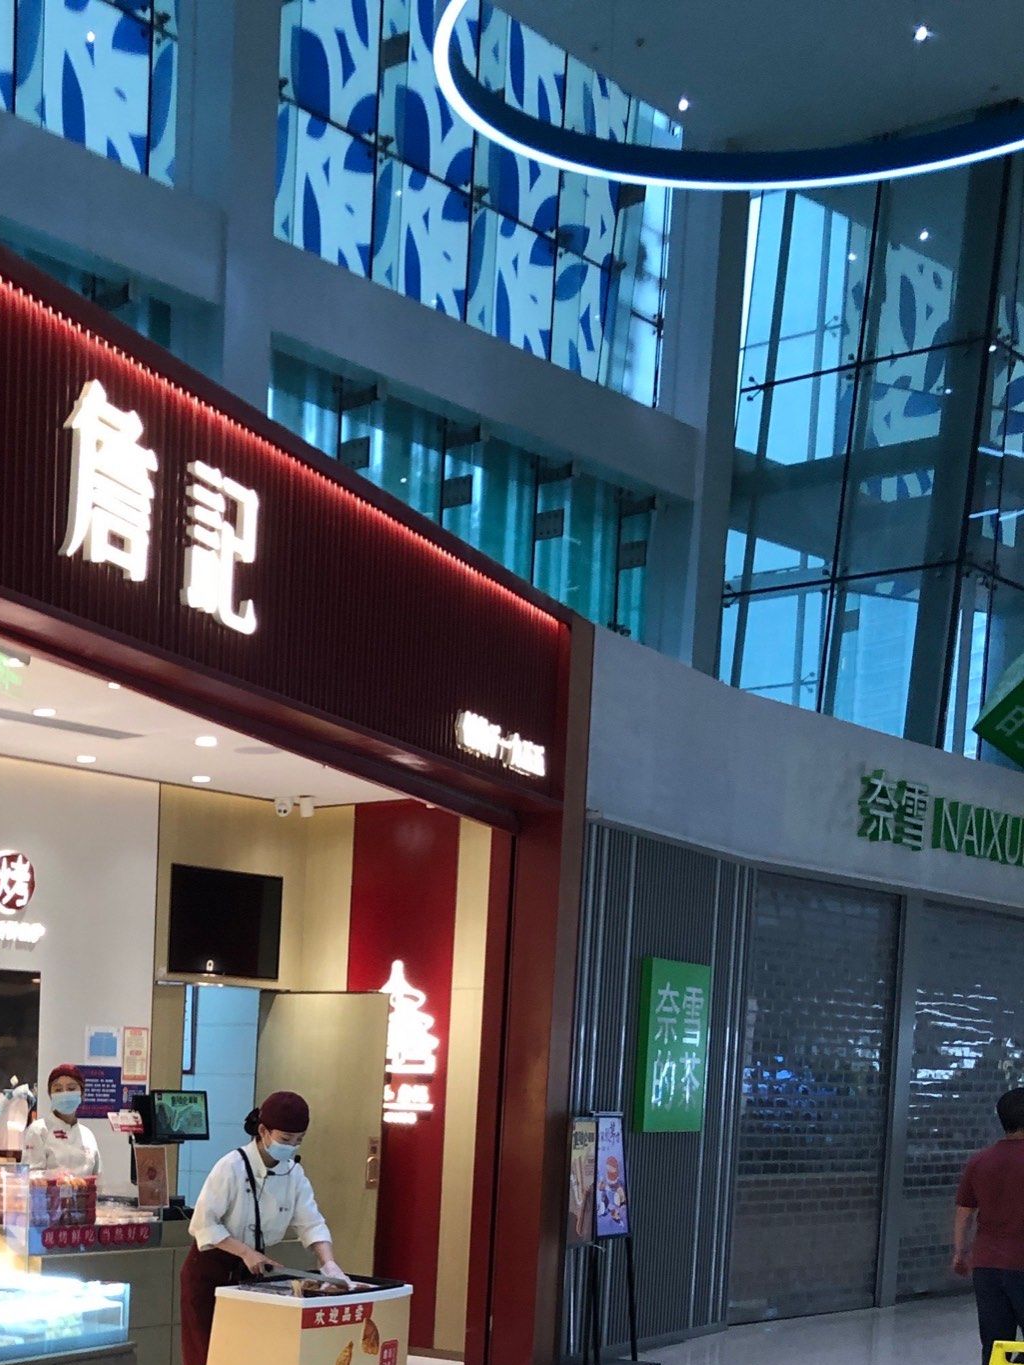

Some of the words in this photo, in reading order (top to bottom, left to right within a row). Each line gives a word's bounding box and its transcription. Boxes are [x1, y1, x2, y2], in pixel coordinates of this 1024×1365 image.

[58, 379, 259, 636] 詹記
[860, 769, 929, 851] 奈雪
[932, 798, 1024, 867] NAIXU
[655, 981, 704, 1047] 奈雪
[651, 1049, 702, 1109] 的茶
